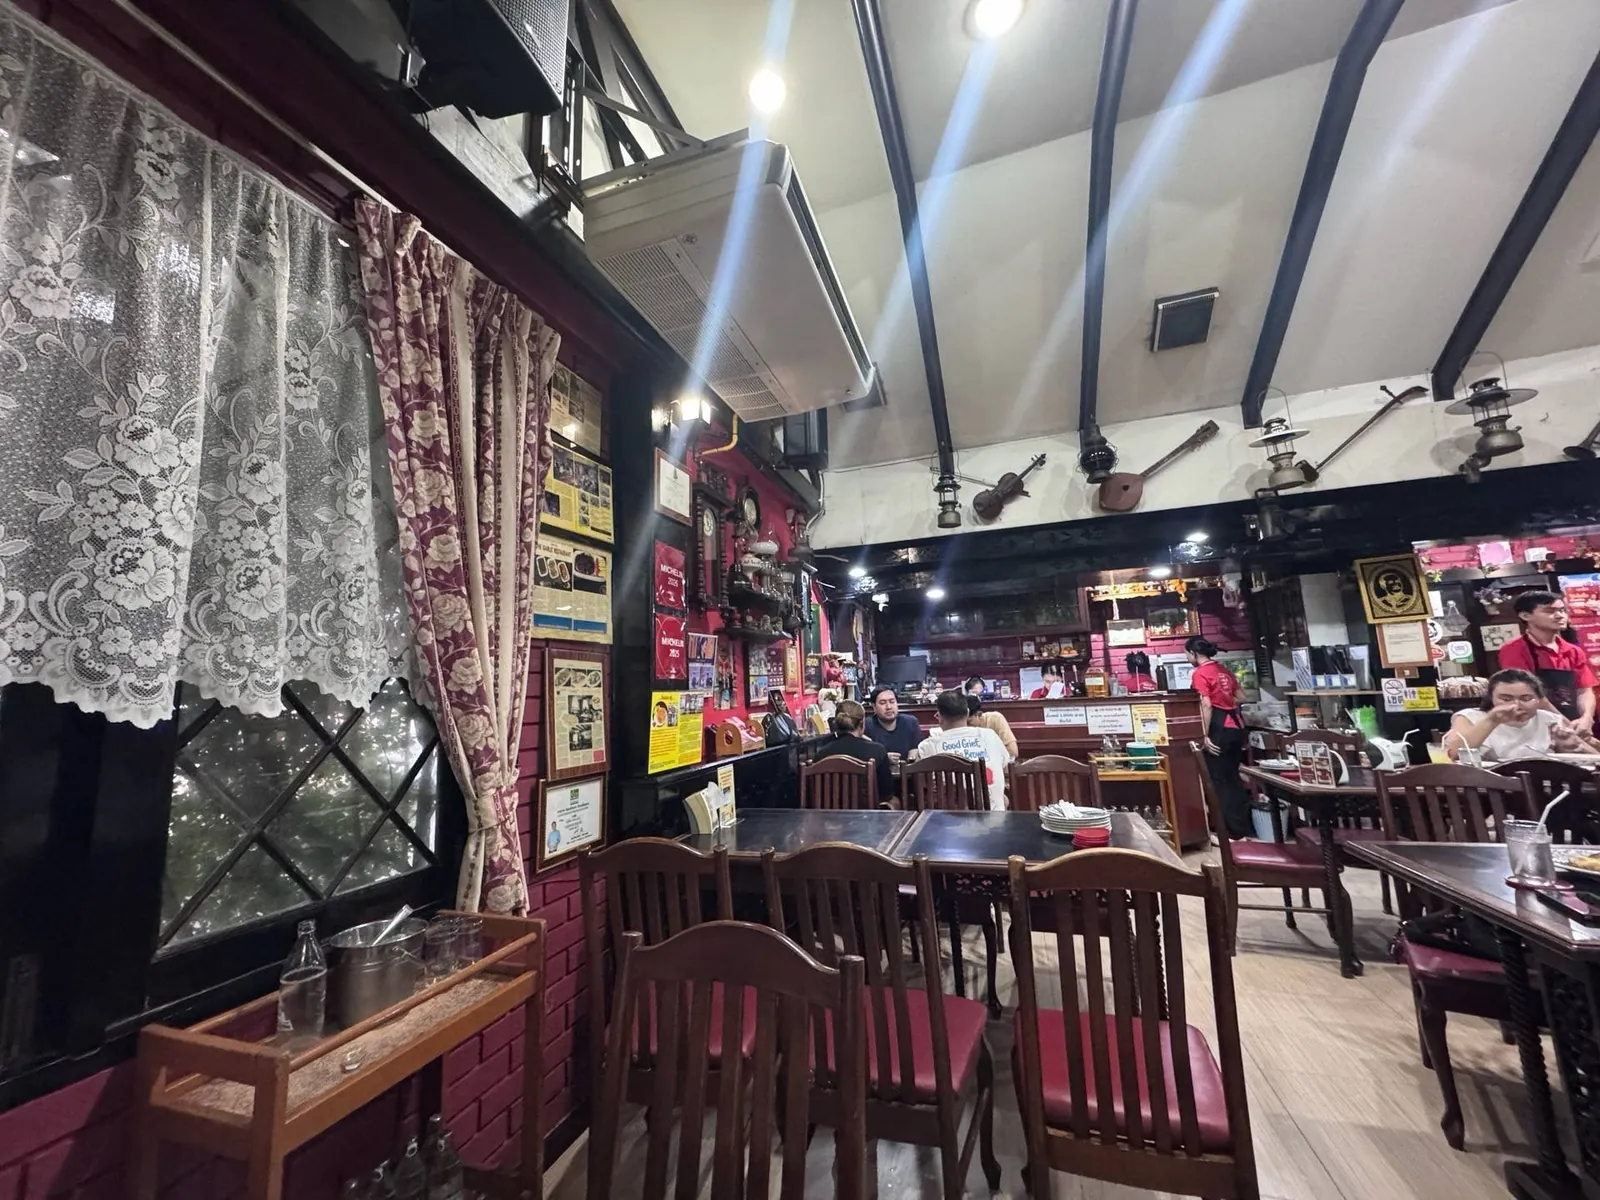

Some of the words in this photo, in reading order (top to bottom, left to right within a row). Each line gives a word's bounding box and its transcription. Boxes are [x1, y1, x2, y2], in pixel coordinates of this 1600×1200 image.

[660, 563, 684, 579] MICHELIN
[661, 637, 684, 648] MICHELIN
[942, 740, 961, 751] Good
[964, 749, 988, 759] Brown!
